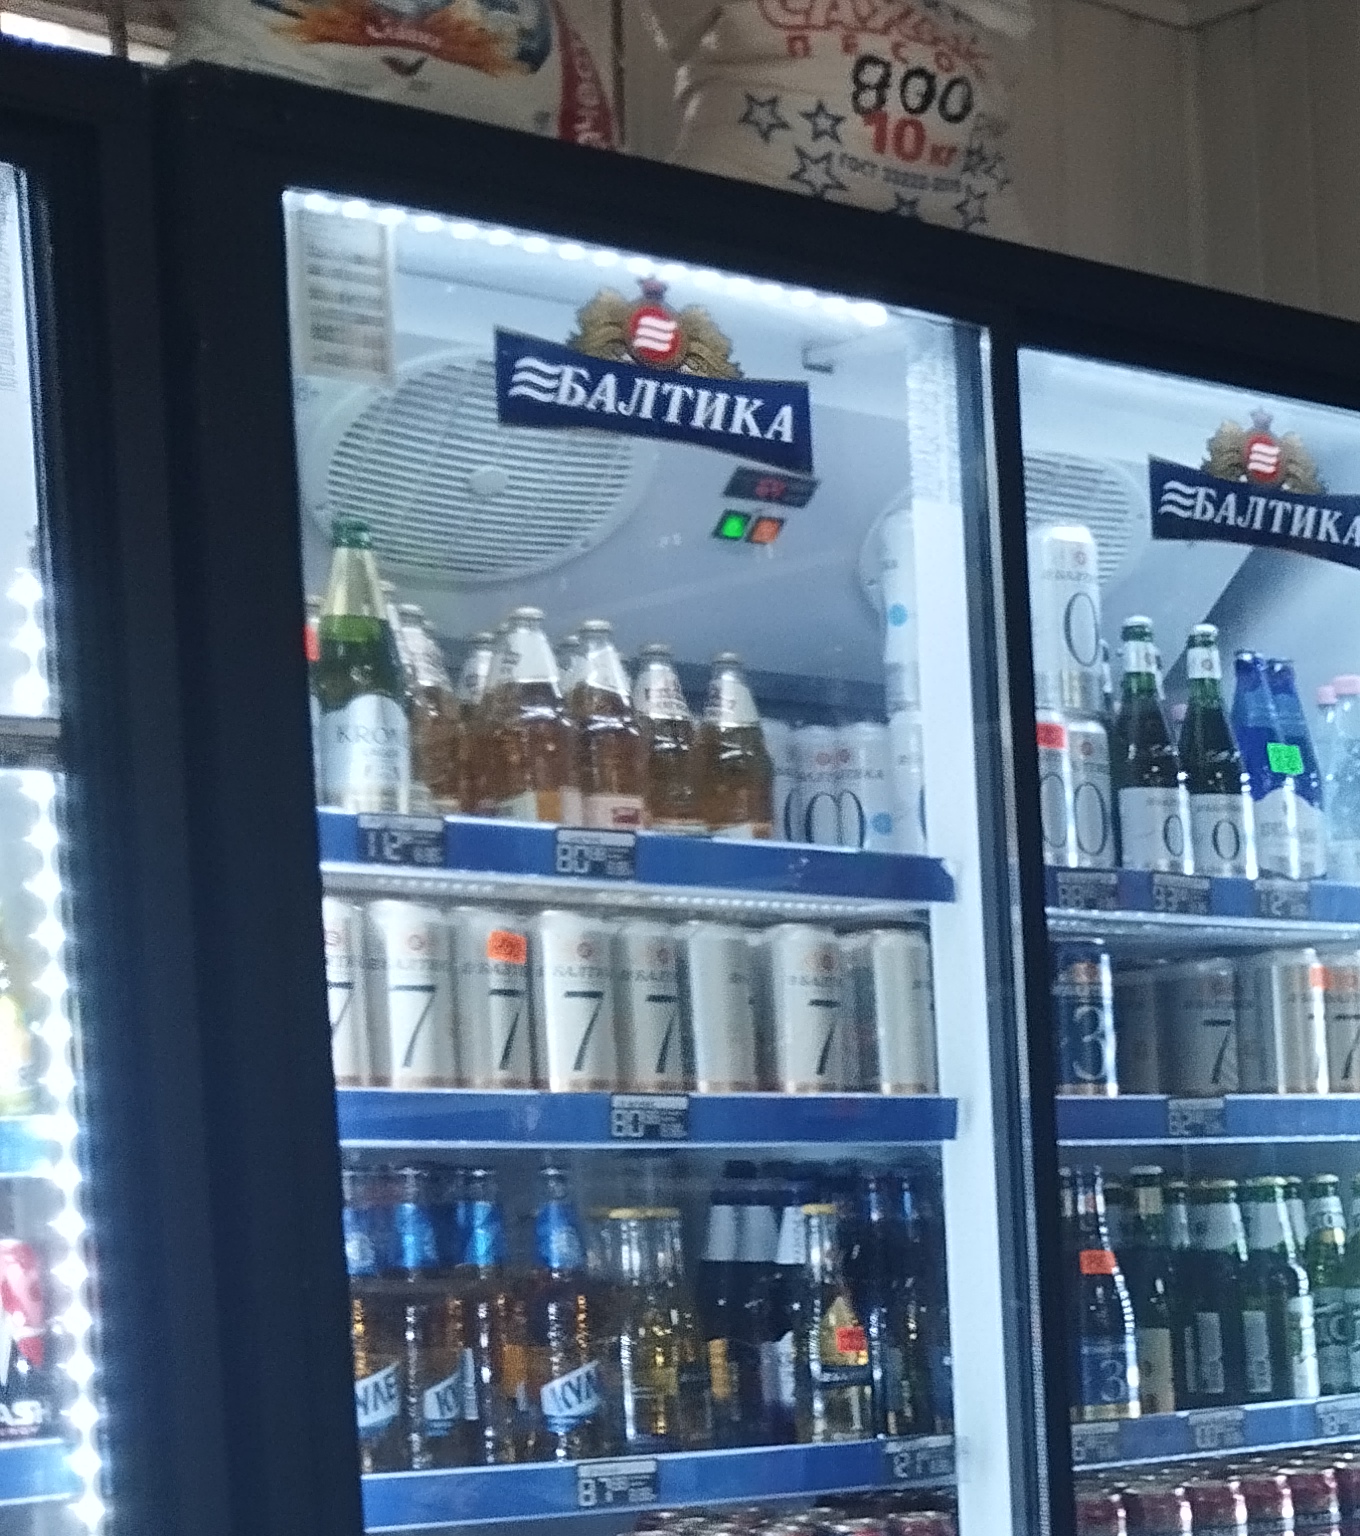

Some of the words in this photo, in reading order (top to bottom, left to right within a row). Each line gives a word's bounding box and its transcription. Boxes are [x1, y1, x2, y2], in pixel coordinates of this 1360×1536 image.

[851, 55, 974, 123] 800
[865, 112, 926, 161] 10
[556, 365, 796, 445] БАЛТИКА
[563, 990, 603, 1073] 7
